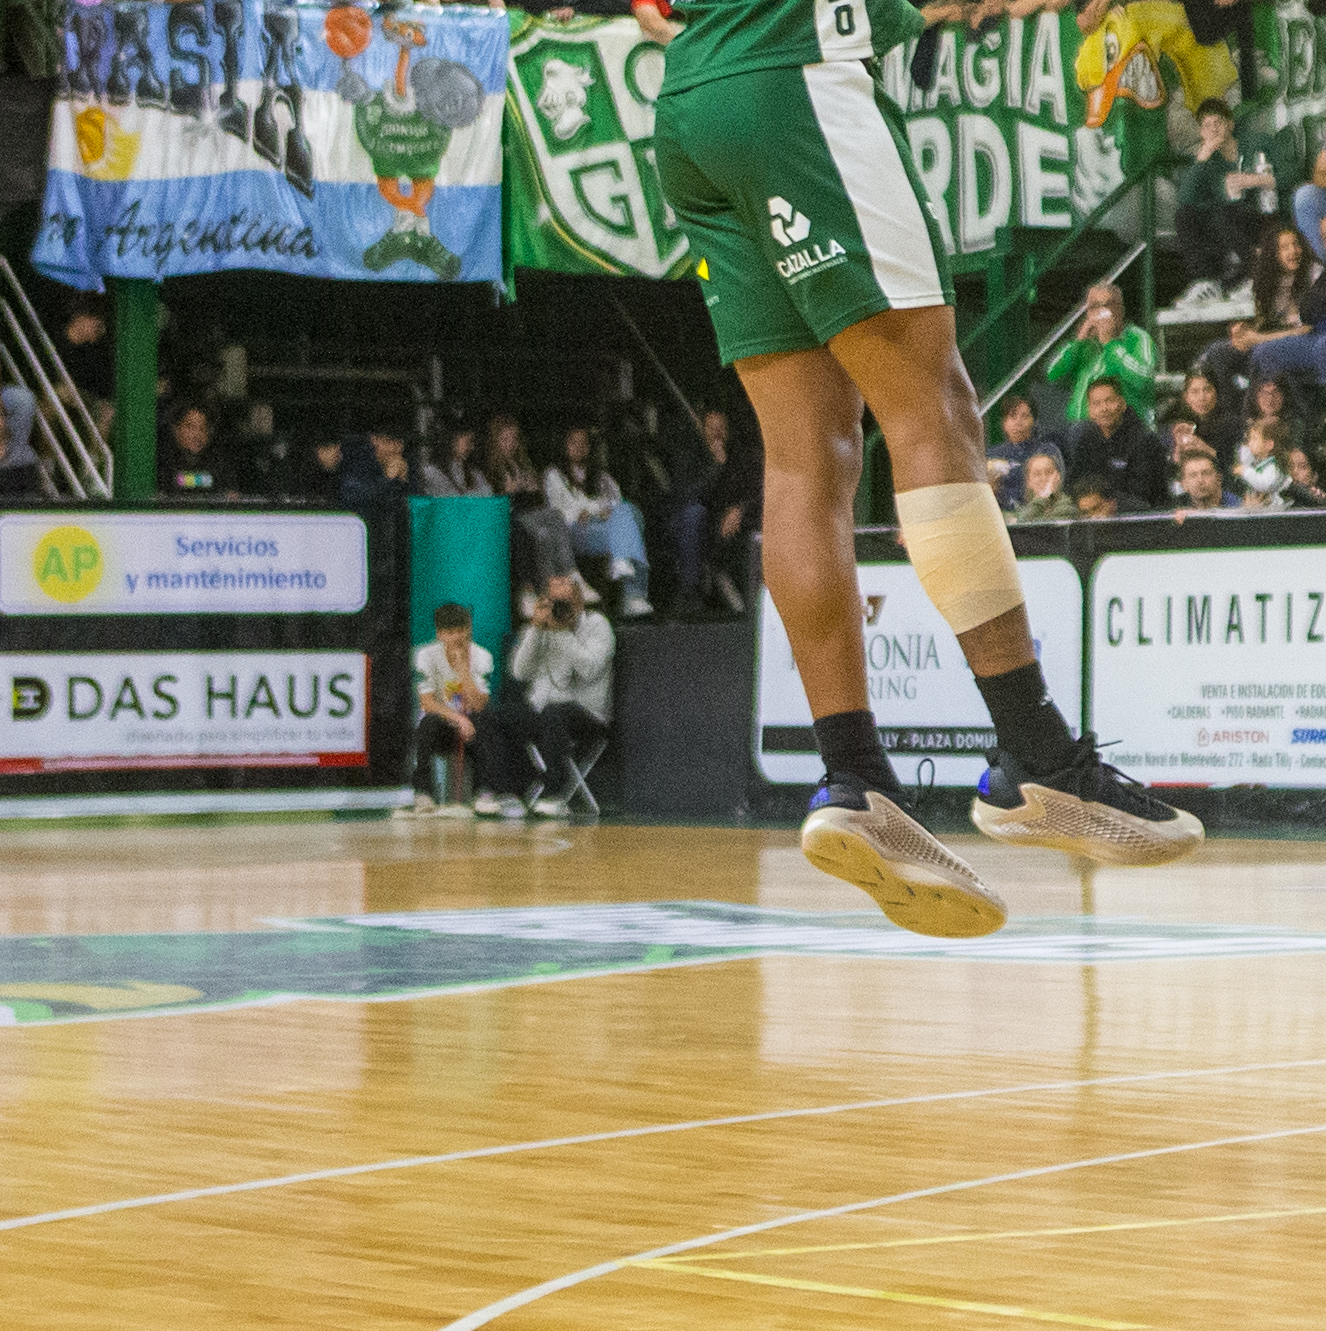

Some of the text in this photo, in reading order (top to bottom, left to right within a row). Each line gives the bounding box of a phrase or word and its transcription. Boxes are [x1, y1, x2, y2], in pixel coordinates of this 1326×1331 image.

[777, 239, 847, 277] CAZALLA
[175, 536, 279, 559] Servicios
[39, 544, 101, 584] AP
[126, 569, 327, 591] y mantenimiento
[68, 673, 354, 720] DAS HAUS
[1201, 684, 1228, 699] VENTA
[1296, 684, 1309, 699] DE
[912, 732, 951, 748] PLAZA
[1212, 730, 1269, 744] ARISTON
